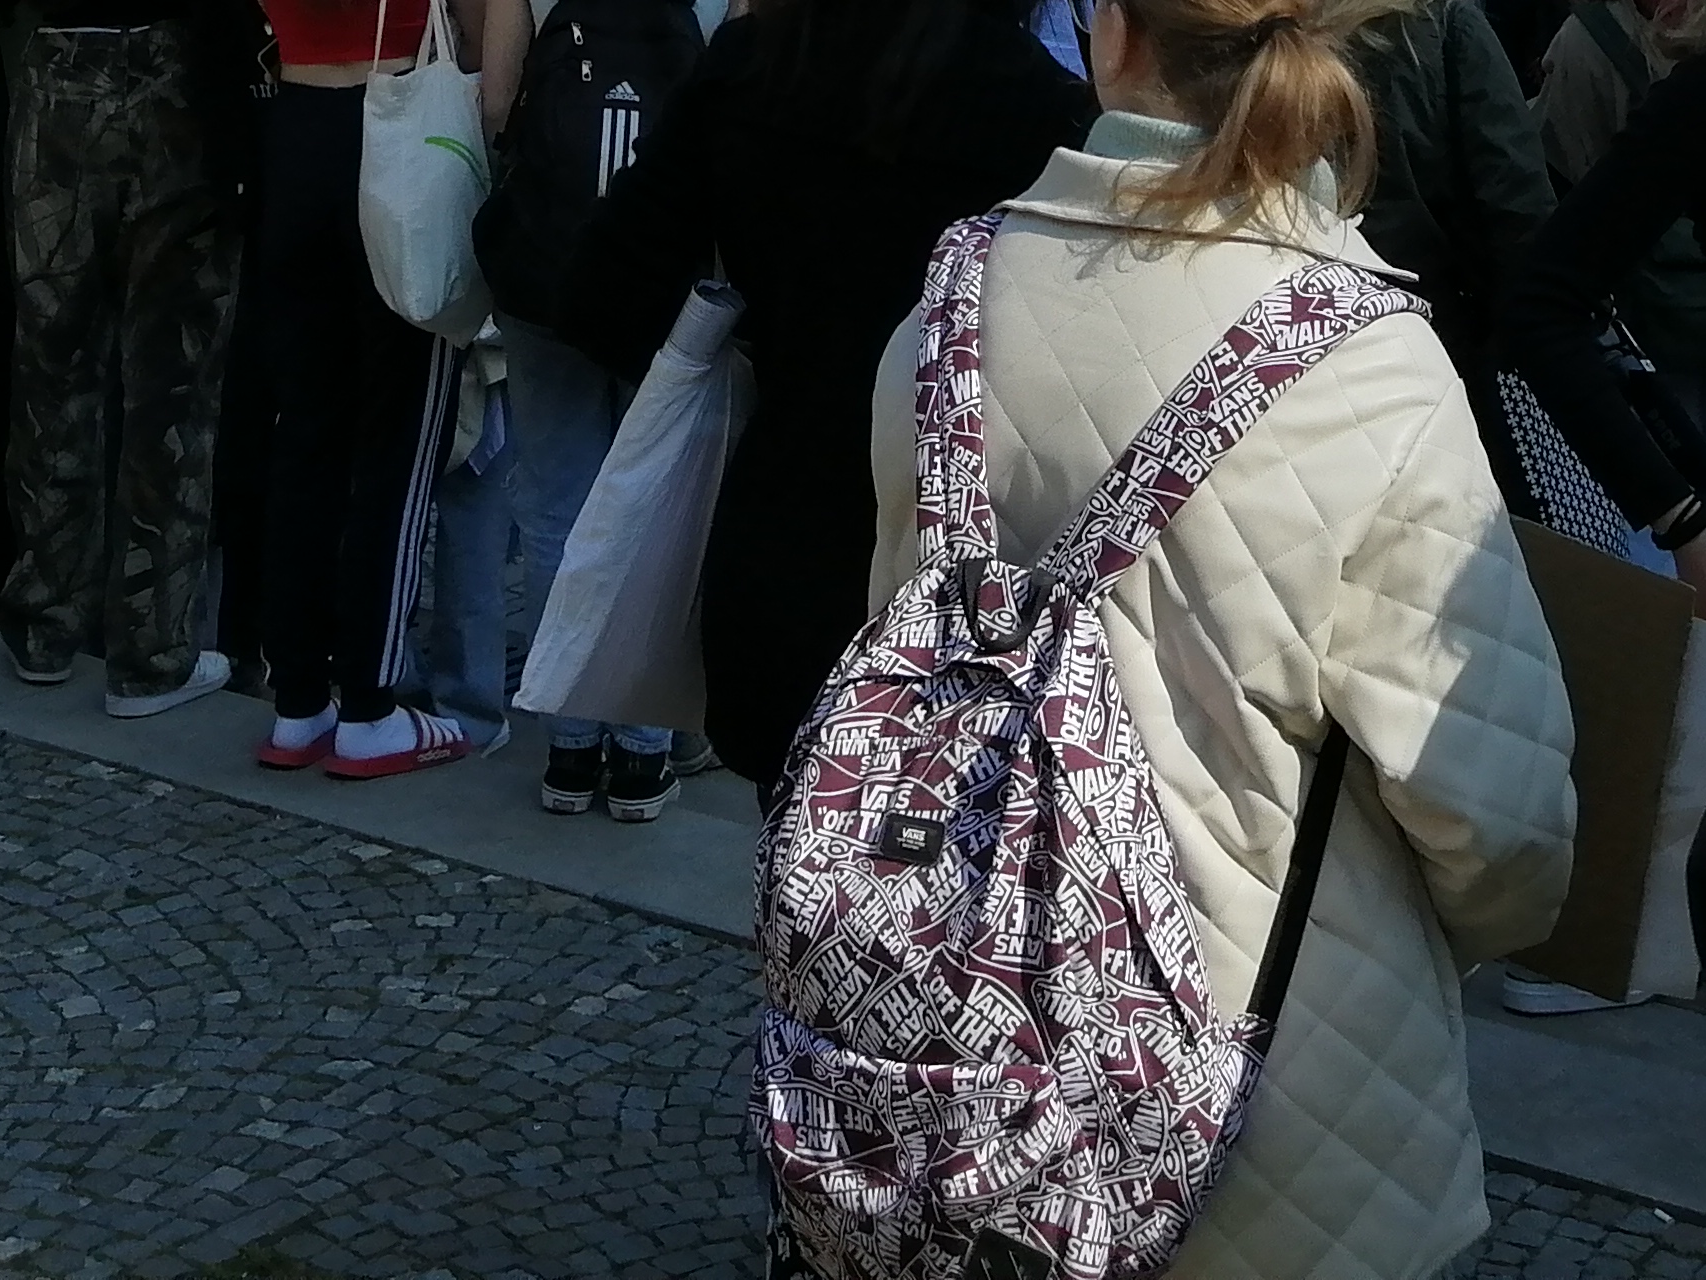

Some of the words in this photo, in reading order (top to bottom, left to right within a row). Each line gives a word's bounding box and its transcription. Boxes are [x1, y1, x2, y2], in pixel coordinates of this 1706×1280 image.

[1208, 374, 1266, 424] VANS
[1070, 648, 1098, 699] THE
[1060, 698, 1083, 743] OFF
[902, 826, 927, 842] VANS
[1054, 872, 1104, 944] VANS
[951, 1003, 999, 1057] THE
[964, 978, 1027, 1038] VANS
[795, 1124, 851, 1158] VANS
[820, 1168, 868, 1191] VANS
